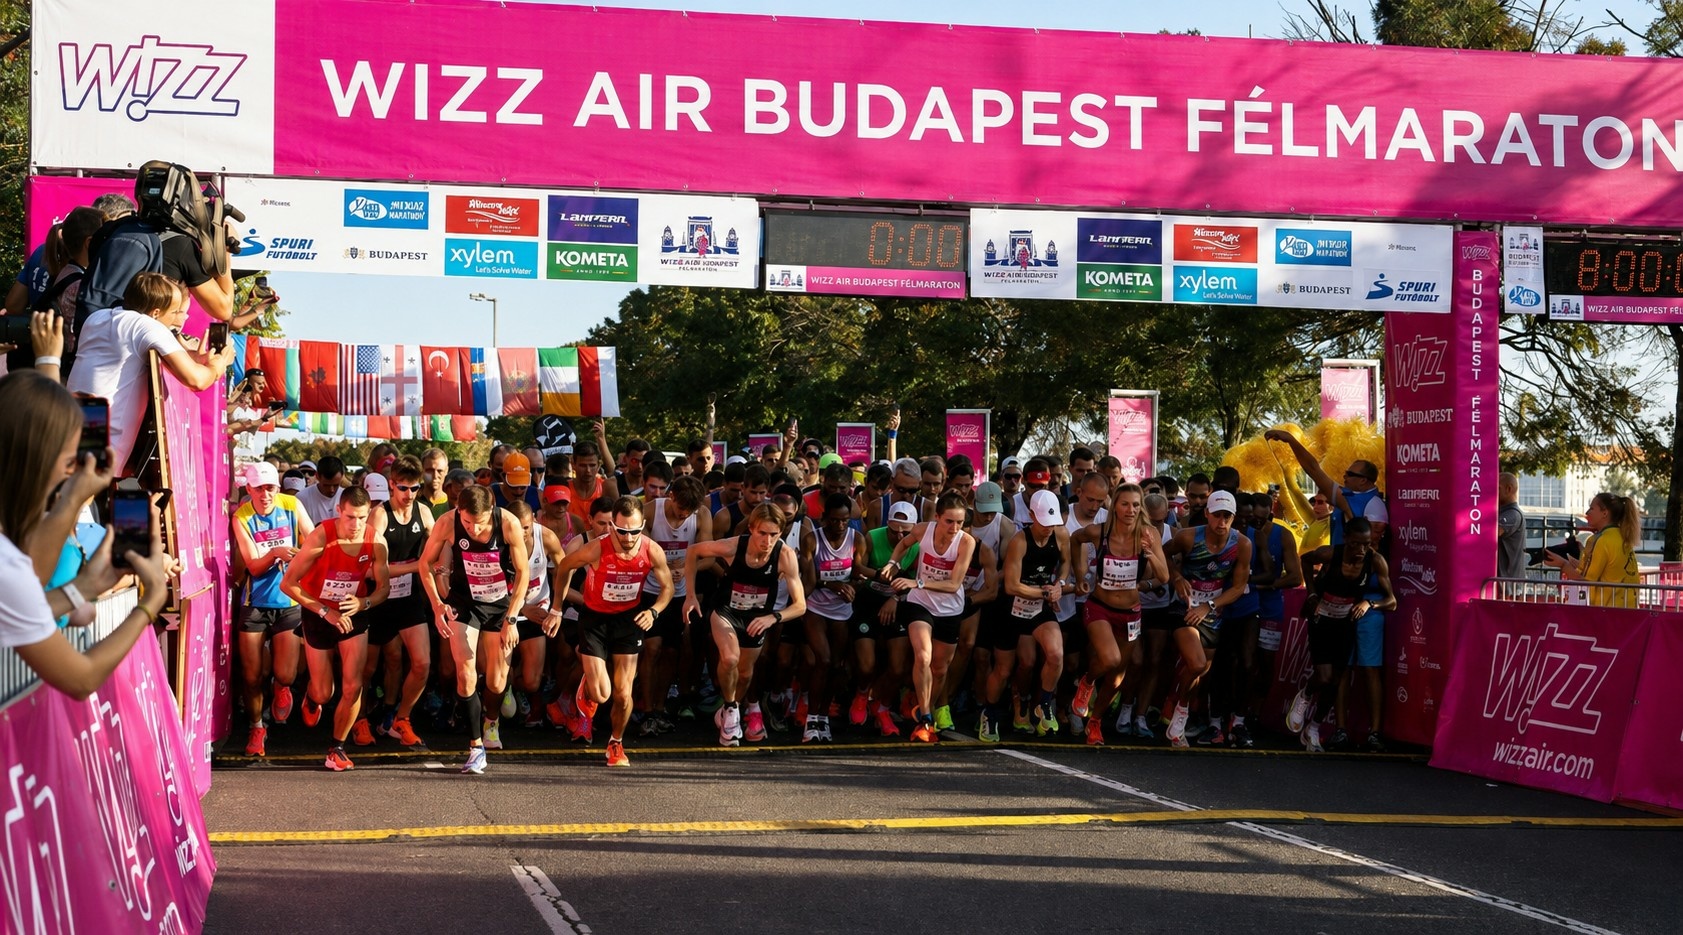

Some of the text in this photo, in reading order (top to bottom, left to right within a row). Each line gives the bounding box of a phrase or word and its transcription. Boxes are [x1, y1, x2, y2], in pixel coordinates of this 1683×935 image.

[320, 59, 1683, 172] WIZZ AIR BUDAPEST FÉLMARATON
[269, 237, 314, 250] SPURI
[868, 220, 963, 268] 0:00
[369, 249, 429, 261] BUDAPEST
[450, 241, 516, 269] xylem
[555, 250, 629, 267] KOMETA
[511, 267, 532, 275] Water
[1085, 270, 1154, 287] KOMETA
[810, 276, 961, 289] WIZZ AIR BUDAPEST FÉLMARATON
[1179, 269, 1238, 295] xylem
[1299, 285, 1351, 295] BUDAPEST
[1398, 281, 1436, 292] SPURI
[1588, 304, 1609, 313] WIZZ
[1610, 305, 1624, 313] AIR
[1625, 305, 1668, 314] BUDAPEST
[1471, 269, 1483, 380] BUDAPEST
[1406, 408, 1453, 424] BUDAPEST
[1397, 443, 1440, 466] KOMETA
[1398, 519, 1428, 546] xylem
[1492, 737, 1594, 780] wizzair.com
